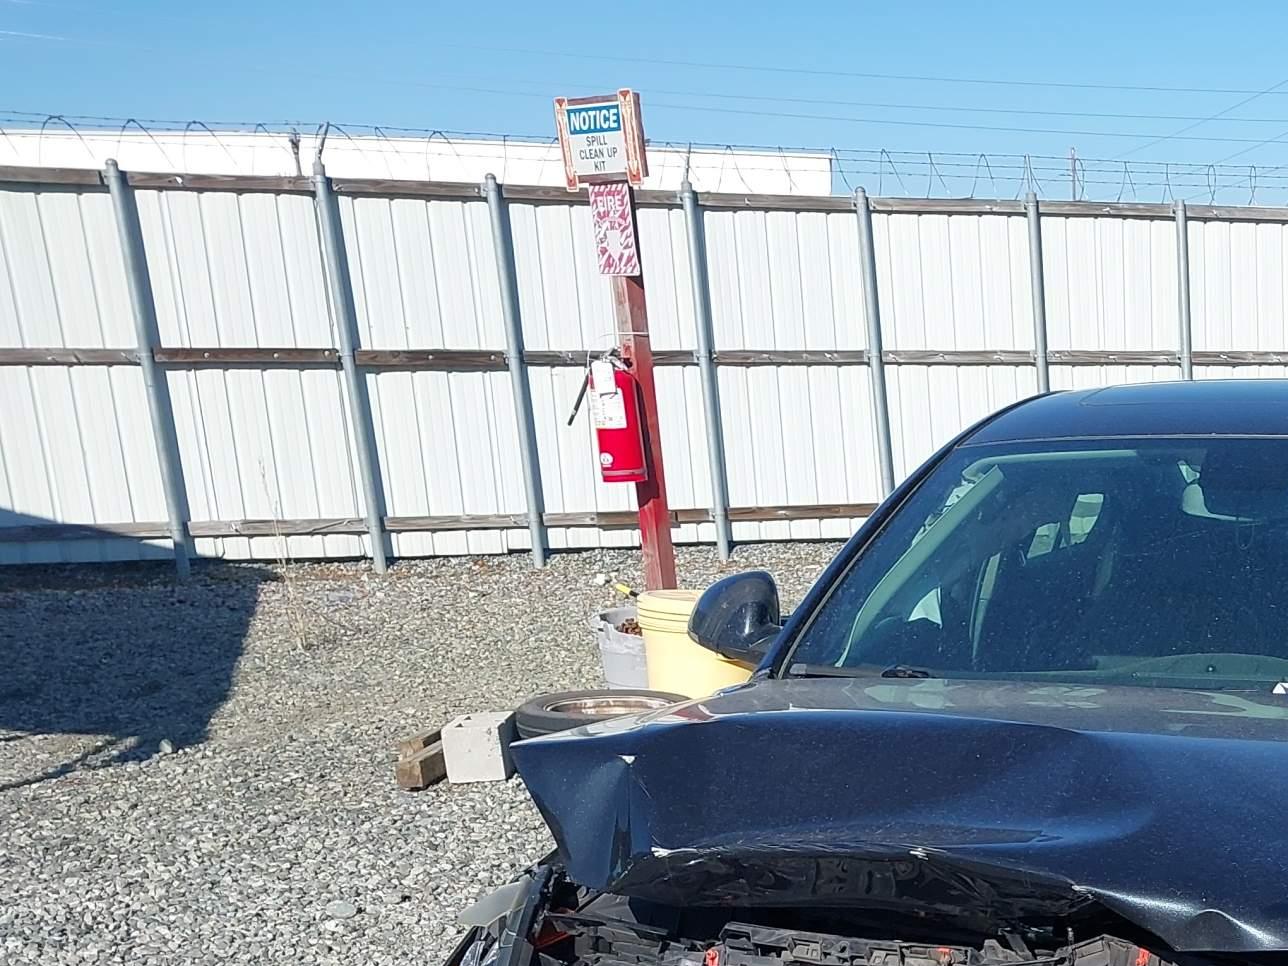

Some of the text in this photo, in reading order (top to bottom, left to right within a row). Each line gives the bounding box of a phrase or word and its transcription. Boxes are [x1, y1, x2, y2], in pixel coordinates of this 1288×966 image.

[570, 108, 618, 132] NOTICE
[585, 135, 608, 147] SPILL
[579, 146, 618, 160] CLEAN UP
[593, 160, 606, 172] KIT
[597, 195, 624, 211] FIRE
